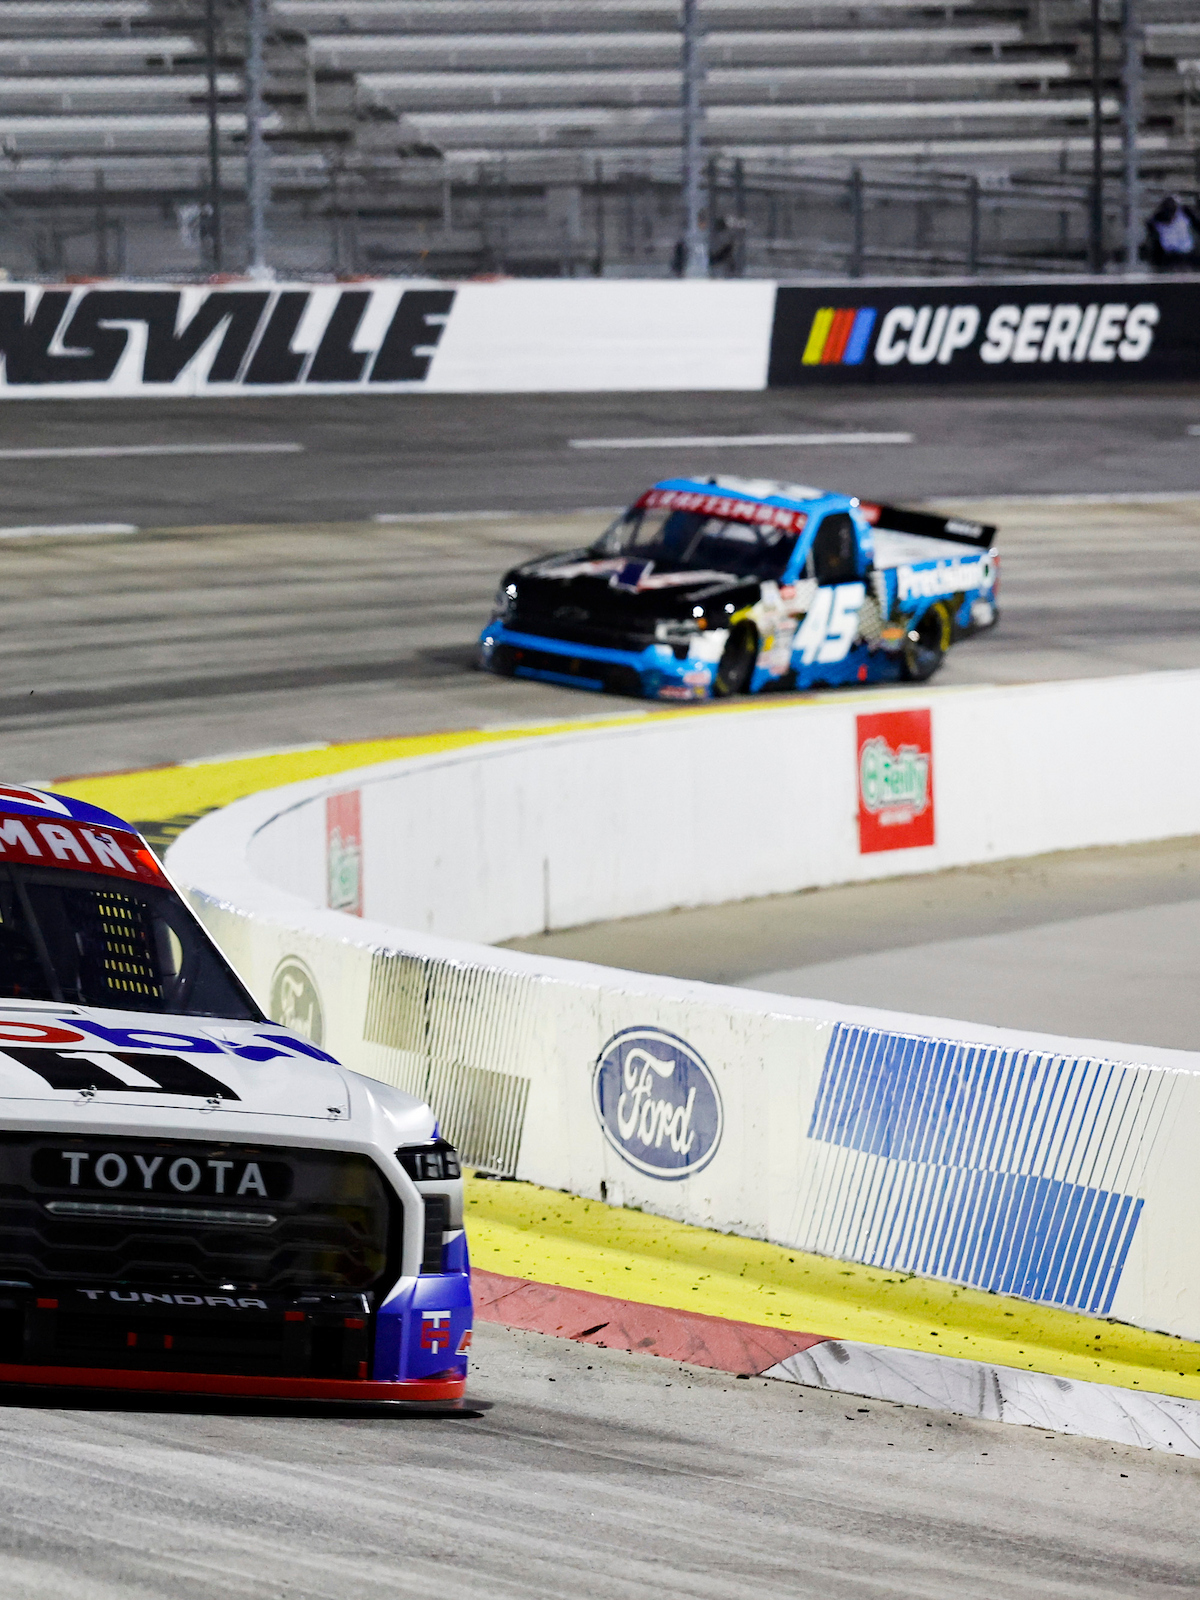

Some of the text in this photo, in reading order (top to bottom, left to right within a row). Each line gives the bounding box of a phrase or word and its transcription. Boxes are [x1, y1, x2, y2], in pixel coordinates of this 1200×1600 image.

[875, 303, 1160, 364] CUP SERIES
[793, 582, 866, 665] 45
[617, 1047, 697, 1155] Ford
[62, 1152, 269, 1197] TOYOTA
[76, 1288, 269, 1310] TUNDRA
